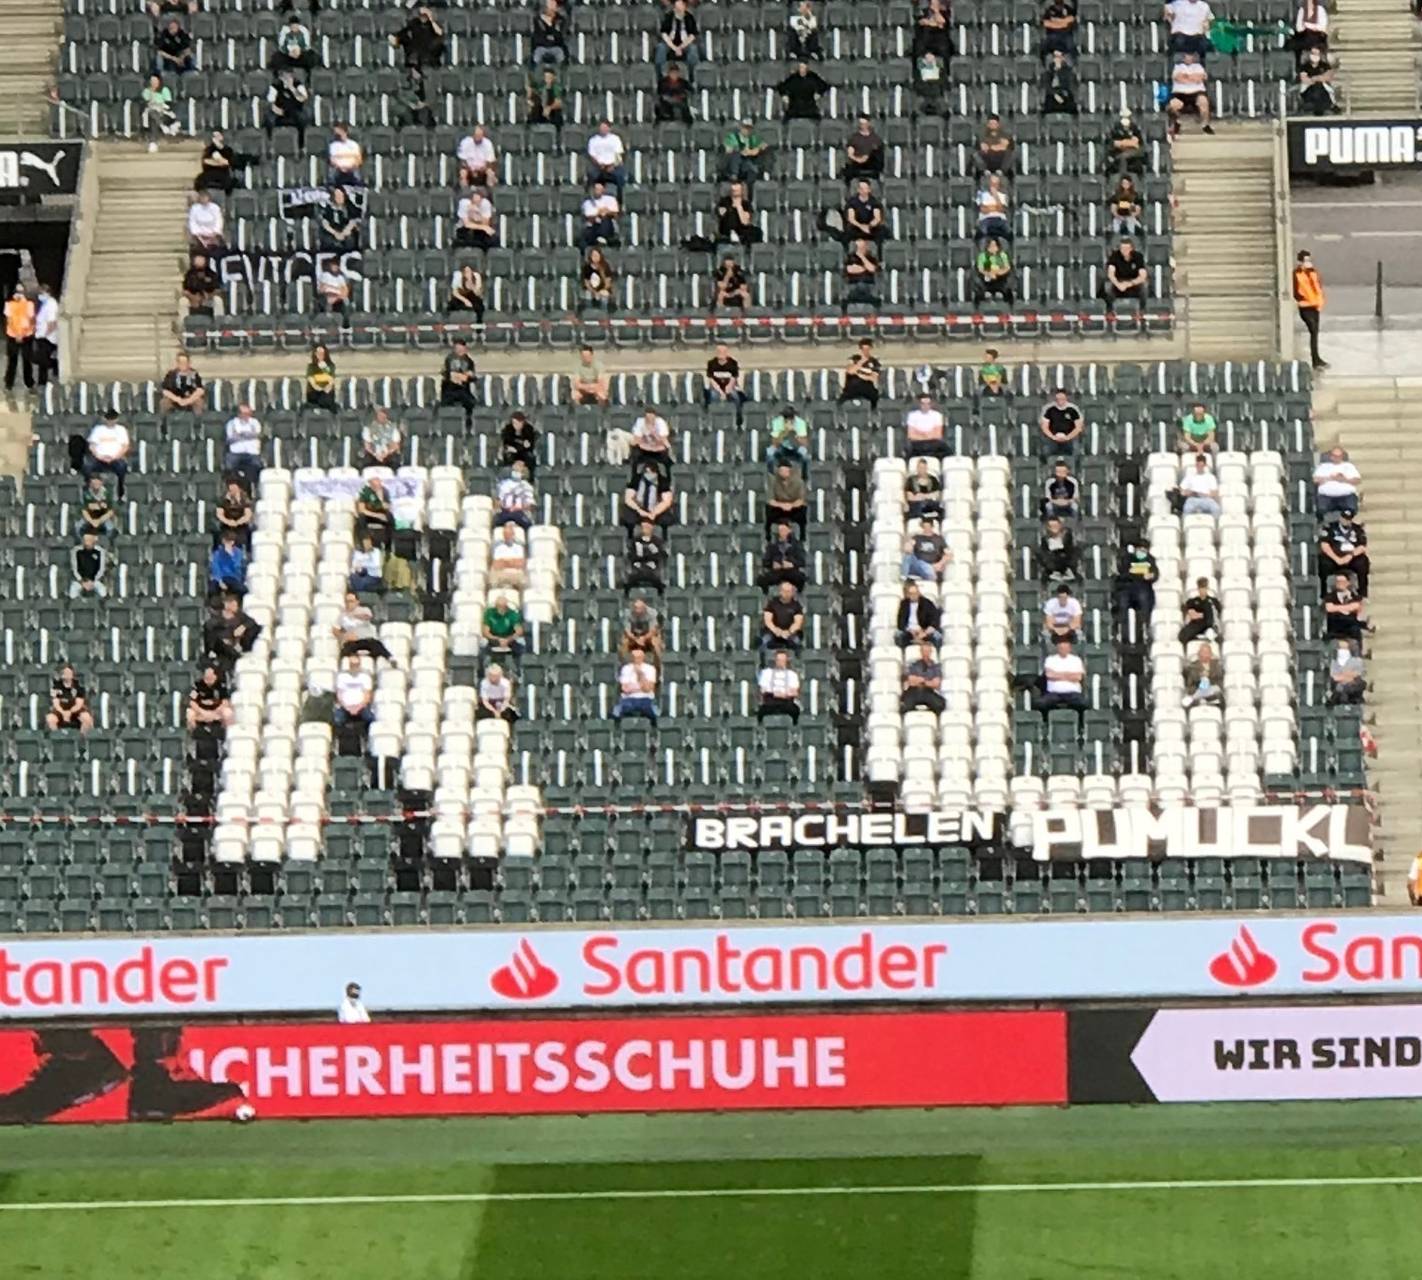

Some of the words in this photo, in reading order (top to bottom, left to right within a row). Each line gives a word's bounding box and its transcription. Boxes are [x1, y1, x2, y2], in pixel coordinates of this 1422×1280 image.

[695, 811, 995, 849] BRACHELEN
[1032, 785, 1373, 863] PUMUCKL
[582, 932, 948, 996] Santander
[189, 1036, 847, 1098] ICHERHEITSSCHUHE
[1213, 1039, 1301, 1070] WIR
[1311, 1036, 1422, 1068] SIND
